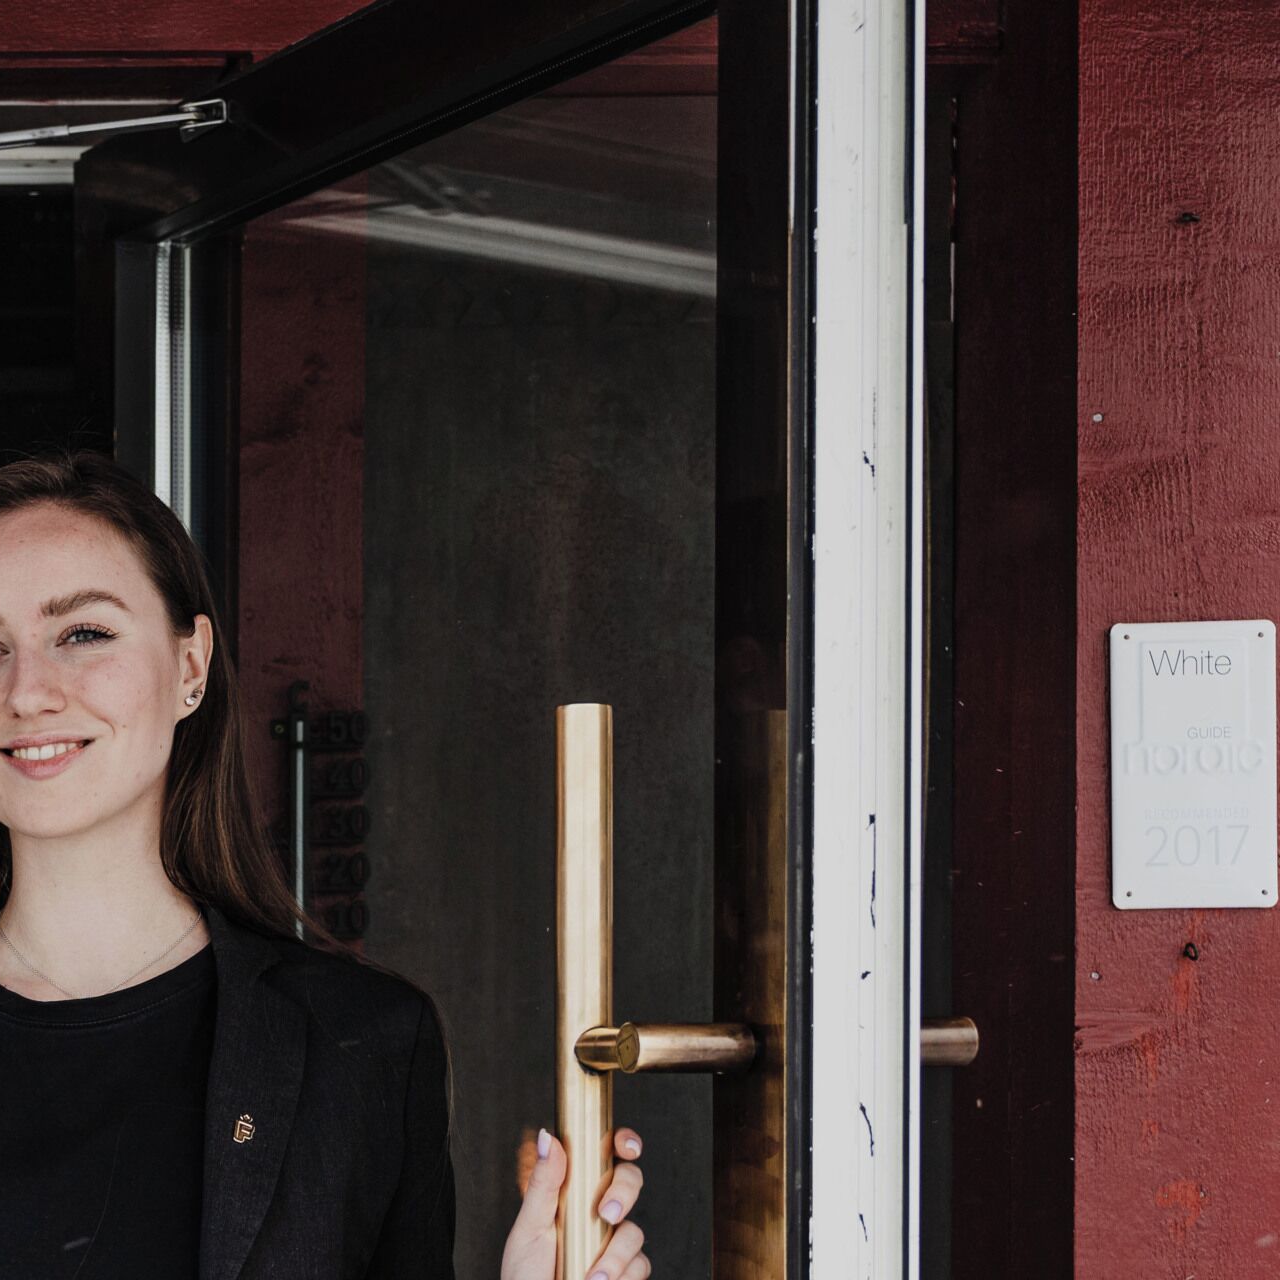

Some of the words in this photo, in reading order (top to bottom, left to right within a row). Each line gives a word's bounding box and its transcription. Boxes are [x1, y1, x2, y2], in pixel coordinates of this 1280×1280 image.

[1148, 649, 1232, 676] White
[328, 711, 369, 744] 50
[1187, 726, 1232, 739] GUIDE
[328, 757, 370, 794] 40
[328, 804, 370, 838] 30
[1144, 825, 1249, 867] 2017
[327, 852, 371, 886] 20
[331, 902, 370, 935] 10
